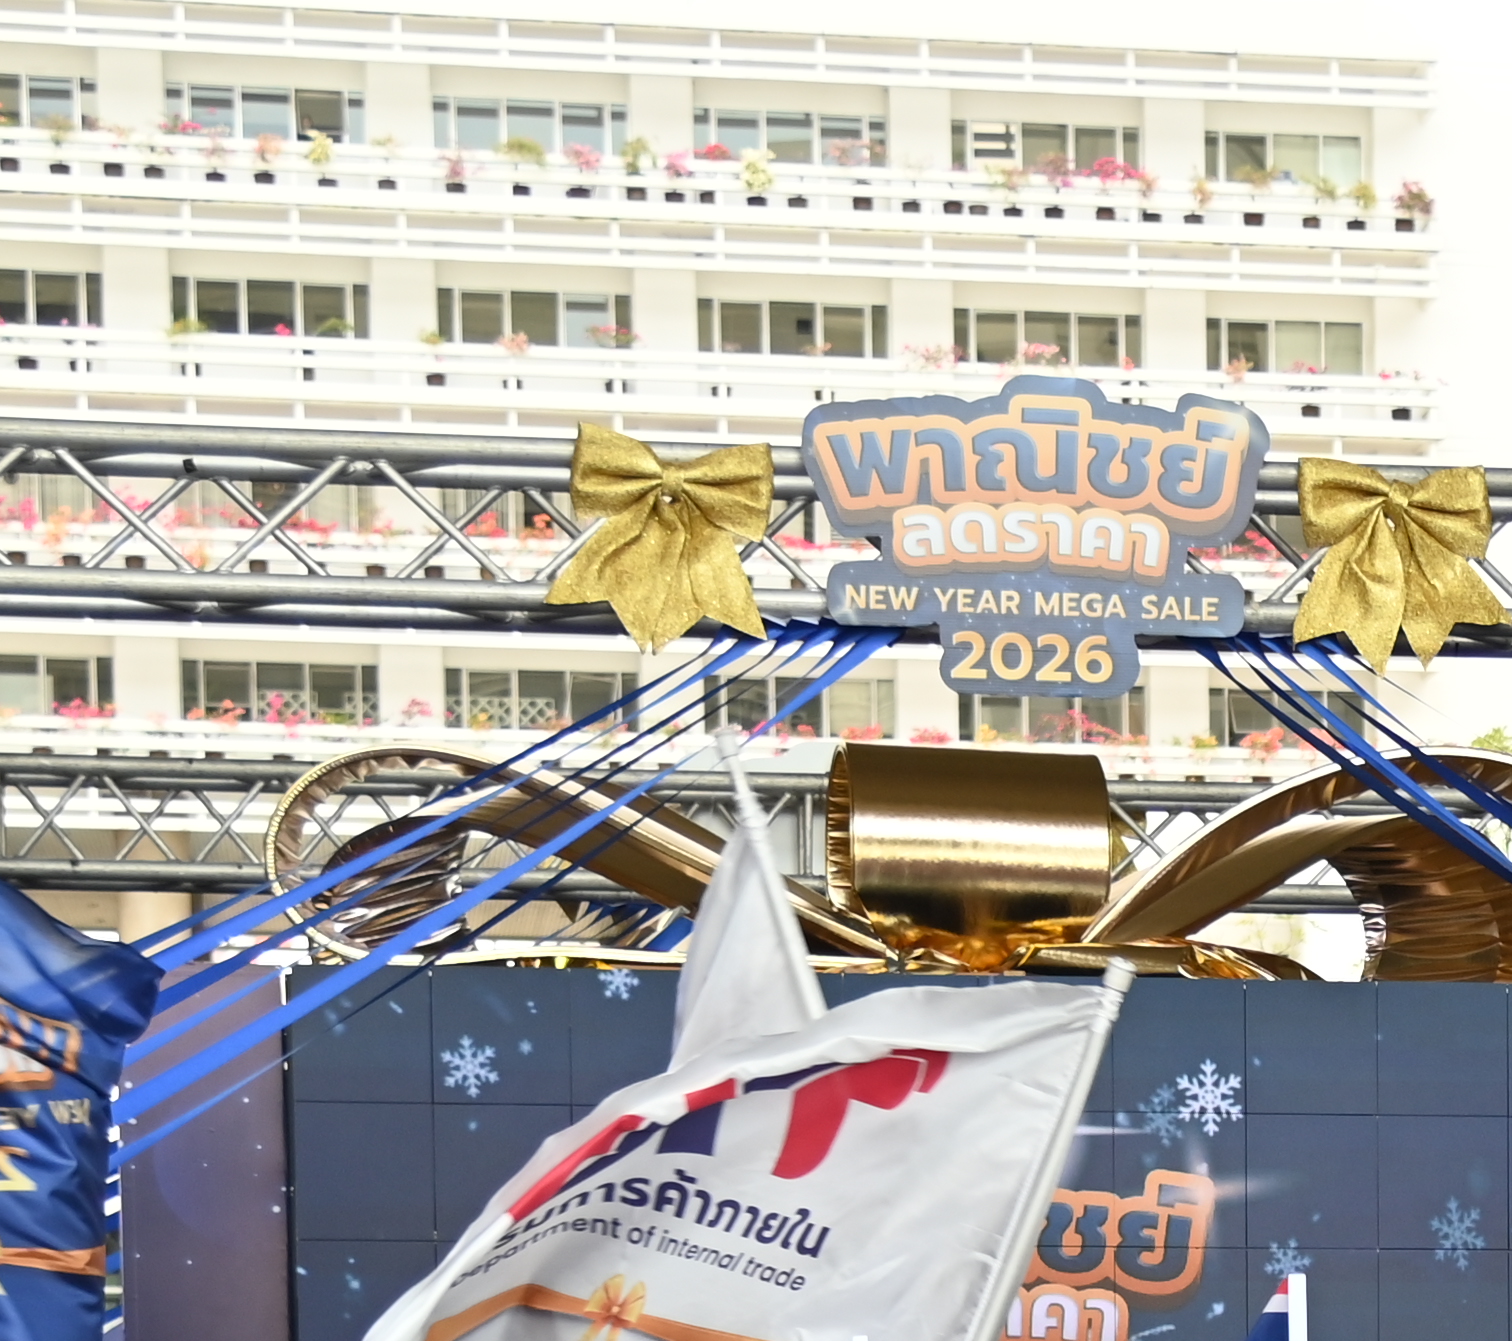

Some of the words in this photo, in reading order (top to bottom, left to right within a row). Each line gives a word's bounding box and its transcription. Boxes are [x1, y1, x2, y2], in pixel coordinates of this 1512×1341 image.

[821, 402, 1240, 512] พาณิชย์
[899, 508, 1162, 569] ลดราคา
[844, 583, 920, 612] NEW
[933, 586, 1021, 617] YEAR
[1034, 590, 1127, 620] MEGA
[1140, 594, 1221, 622] SALE
[949, 630, 1116, 684] 2026
[625, 1224, 653, 1248] of
[654, 1230, 740, 1271] internal
[738, 1250, 804, 1291] trade
